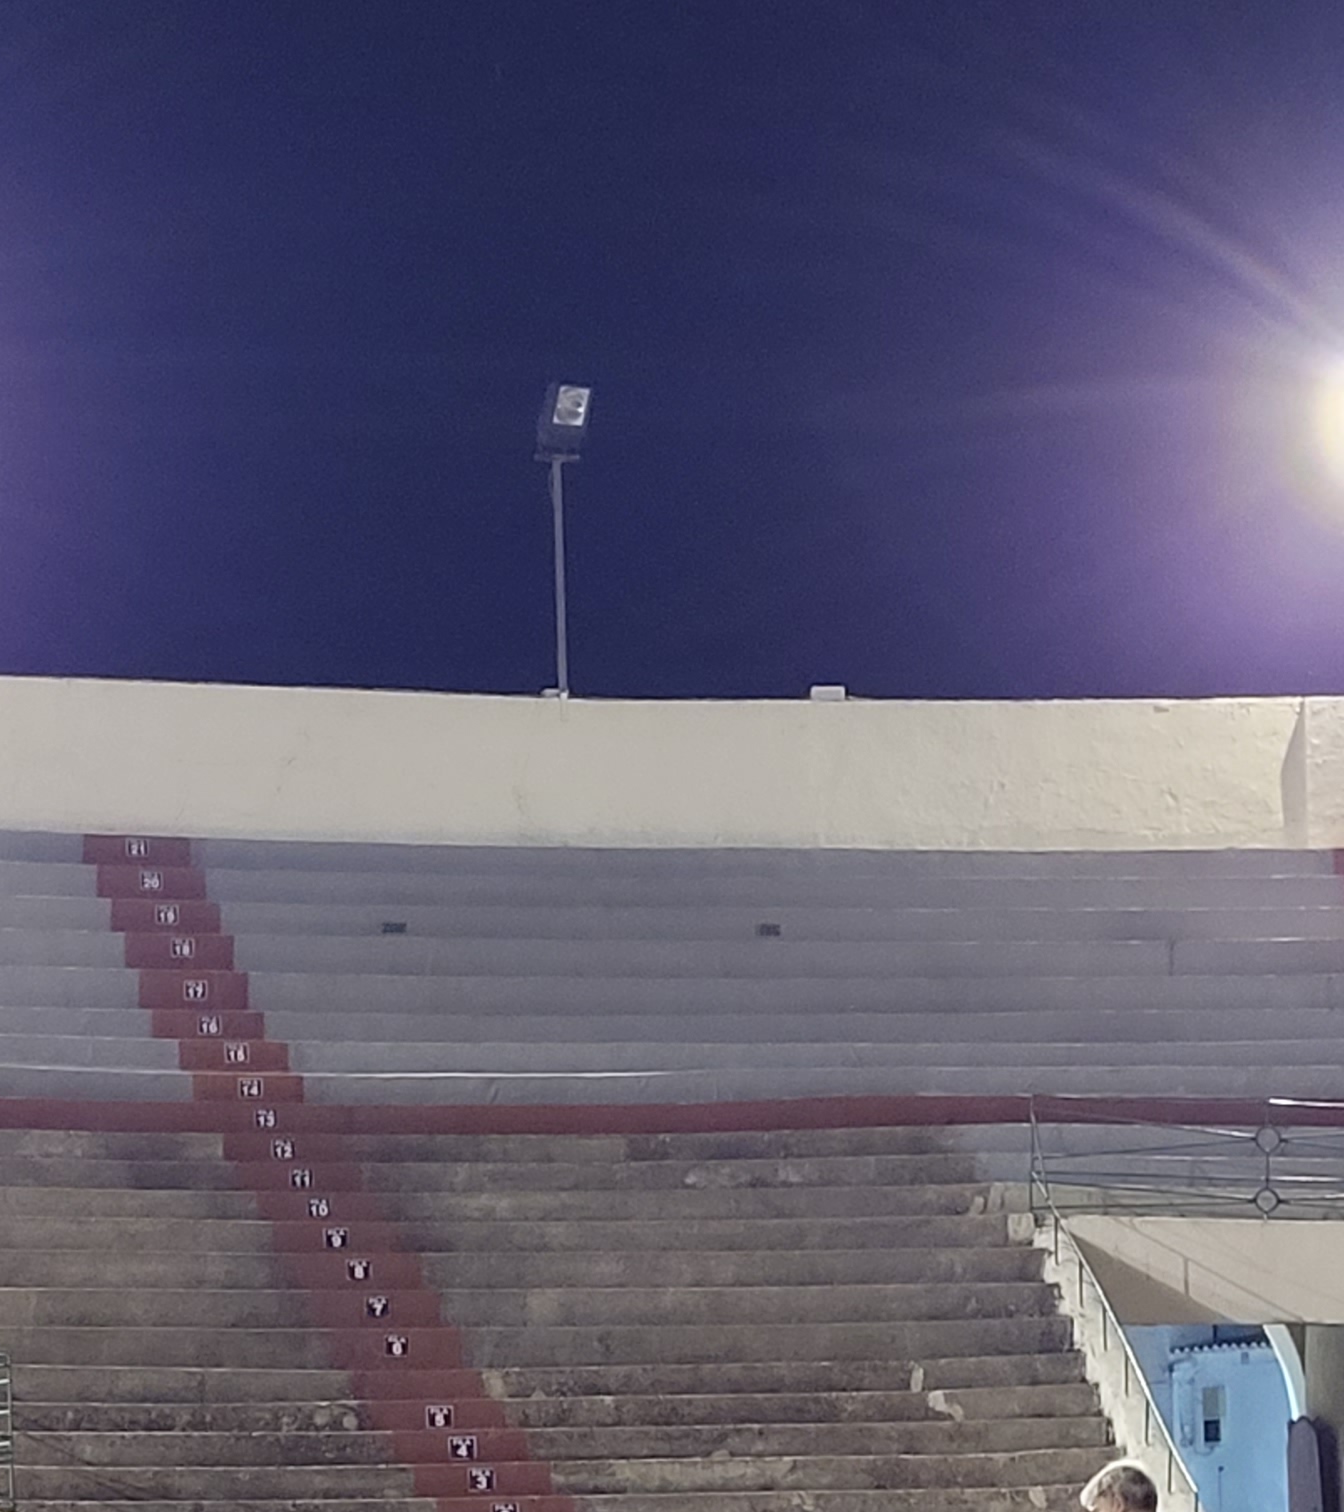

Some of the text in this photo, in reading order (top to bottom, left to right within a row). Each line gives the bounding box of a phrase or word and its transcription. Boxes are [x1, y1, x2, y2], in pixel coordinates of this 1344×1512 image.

[258, 1115, 274, 1127] 13
[276, 1146, 293, 1158] 12
[294, 1175, 310, 1188] 11
[311, 1204, 328, 1216] 10
[373, 1303, 383, 1316] 7
[456, 1445, 468, 1457] 4
[476, 1475, 487, 1489] 3
